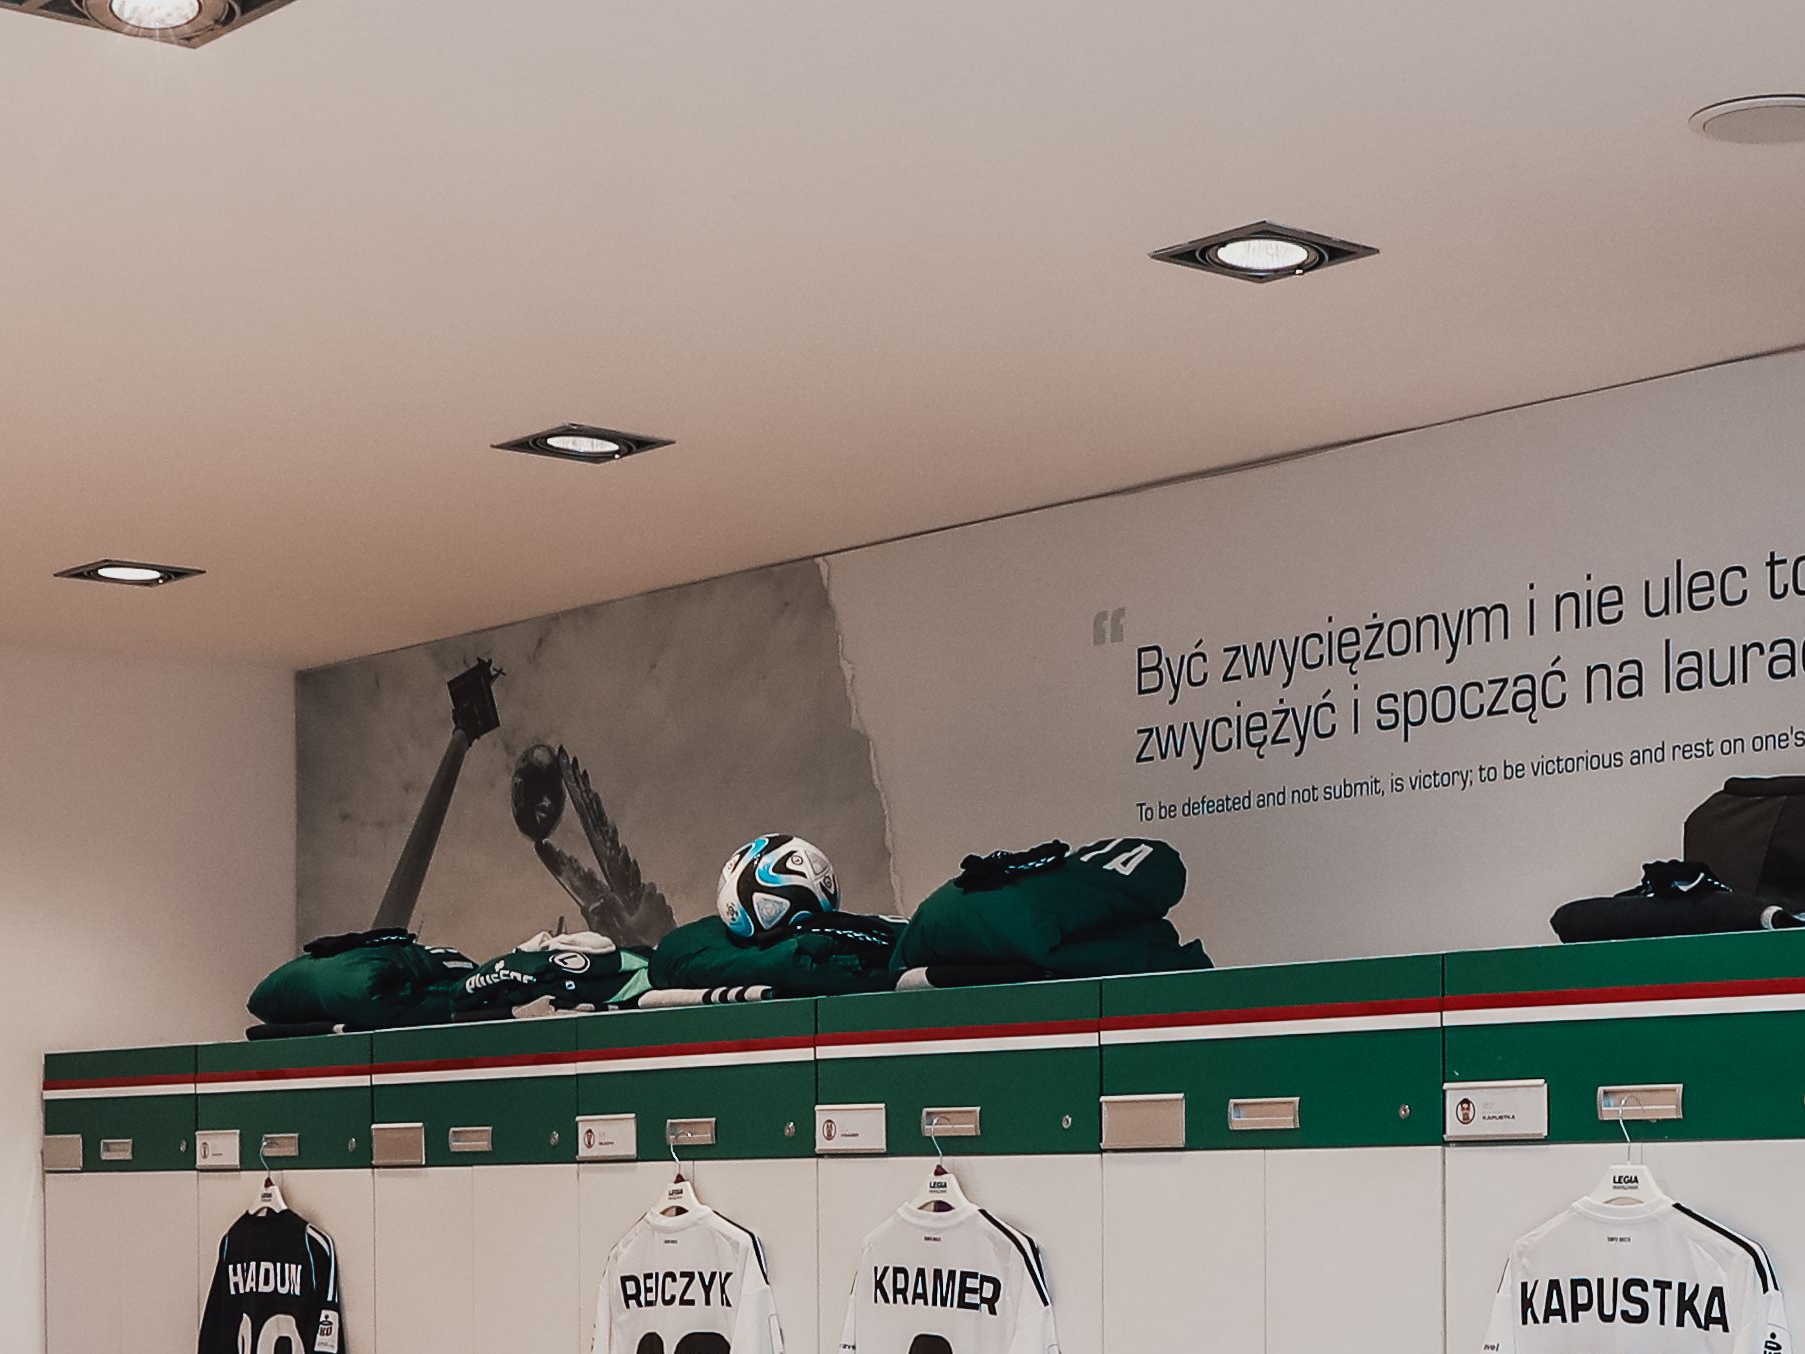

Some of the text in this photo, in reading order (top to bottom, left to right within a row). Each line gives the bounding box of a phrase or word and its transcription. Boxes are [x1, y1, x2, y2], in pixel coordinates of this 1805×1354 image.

[1136, 639, 1208, 704] Być
[1221, 602, 1509, 688] zwyciężonym
[1528, 583, 1536, 636] i
[1555, 574, 1624, 632] nie
[1644, 559, 1748, 618] ulec
[1135, 688, 1337, 770] zwyciężyć
[1352, 684, 1360, 734] i
[1376, 655, 1567, 742] spocząć
[1586, 659, 1643, 703] na
[1136, 803, 1154, 822] To
[1159, 801, 1178, 820] be
[1182, 792, 1252, 817] defeated
[1256, 787, 1286, 808] and
[1292, 784, 1319, 804] not
[1323, 776, 1385, 800] submit,
[1390, 773, 1405, 793] is
[1409, 767, 1474, 792] victory;
[1478, 763, 1498, 783] to
[1504, 760, 1525, 780] be
[1531, 749, 1623, 776] victorious
[1629, 742, 1665, 766] and
[1672, 739, 1714, 761] rest
[1720, 738, 1744, 758] on
[1752, 726, 1805, 752] one's
[1613, 1175, 1639, 1184] LEGIA
[228, 1261, 302, 1296] HADUN
[873, 1265, 1002, 1316] KRAMER
[1520, 1278, 1730, 1333] KAPUSTKA
